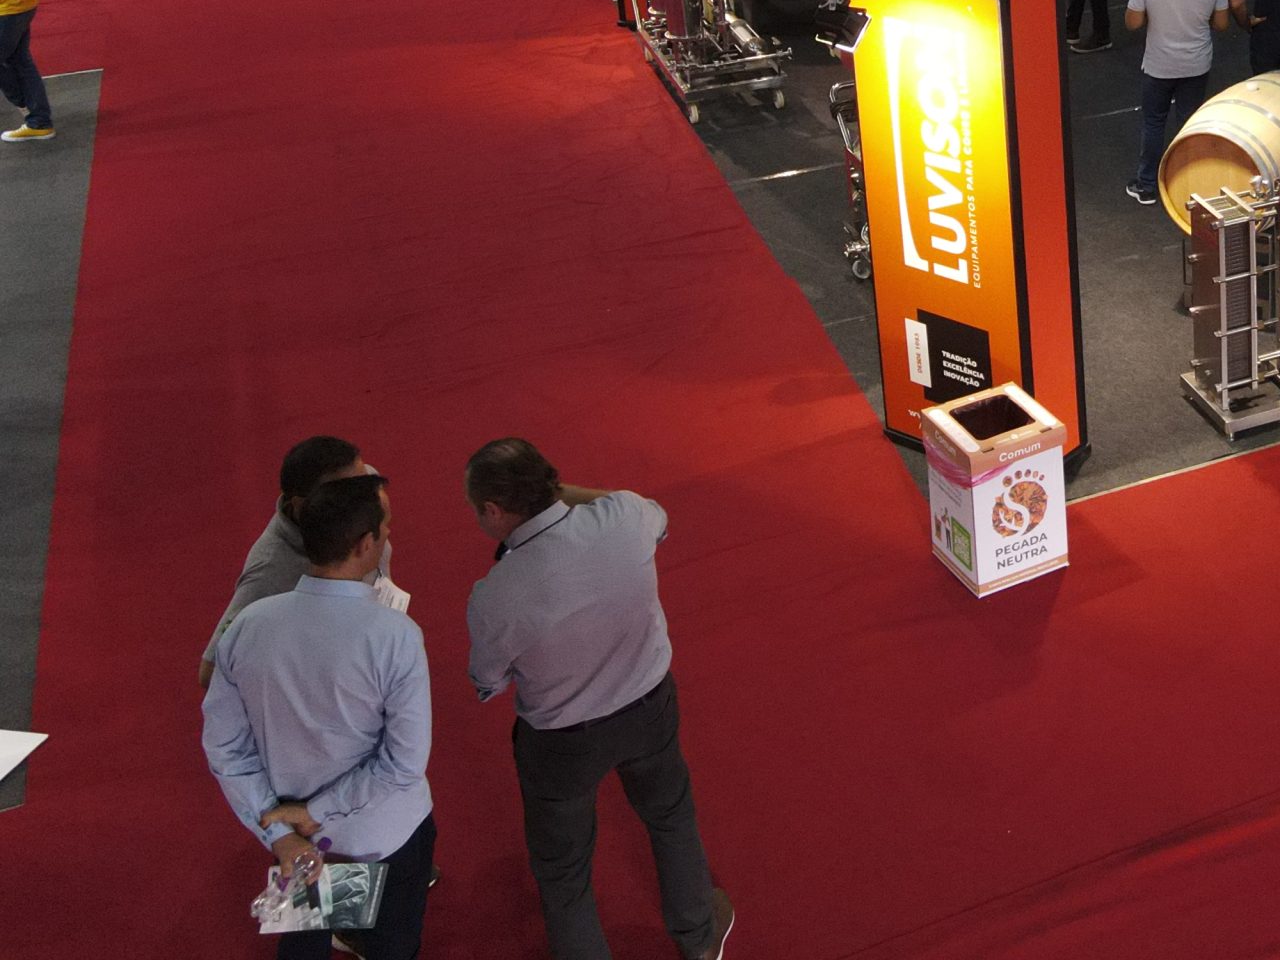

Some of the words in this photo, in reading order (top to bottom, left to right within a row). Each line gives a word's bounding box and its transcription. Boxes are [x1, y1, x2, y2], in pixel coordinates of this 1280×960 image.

[966, 160, 975, 192] PARA
[967, 195, 981, 289] EQUIPAMENTOS
[941, 350, 978, 368] TRADIÇÃO
[942, 360, 985, 380] EXCELÊNCIA
[943, 370, 980, 388] INOVAÇÃO
[999, 441, 1041, 463] Comum
[995, 532, 1048, 558] PEGADA
[996, 545, 1048, 570] NEUTRA
